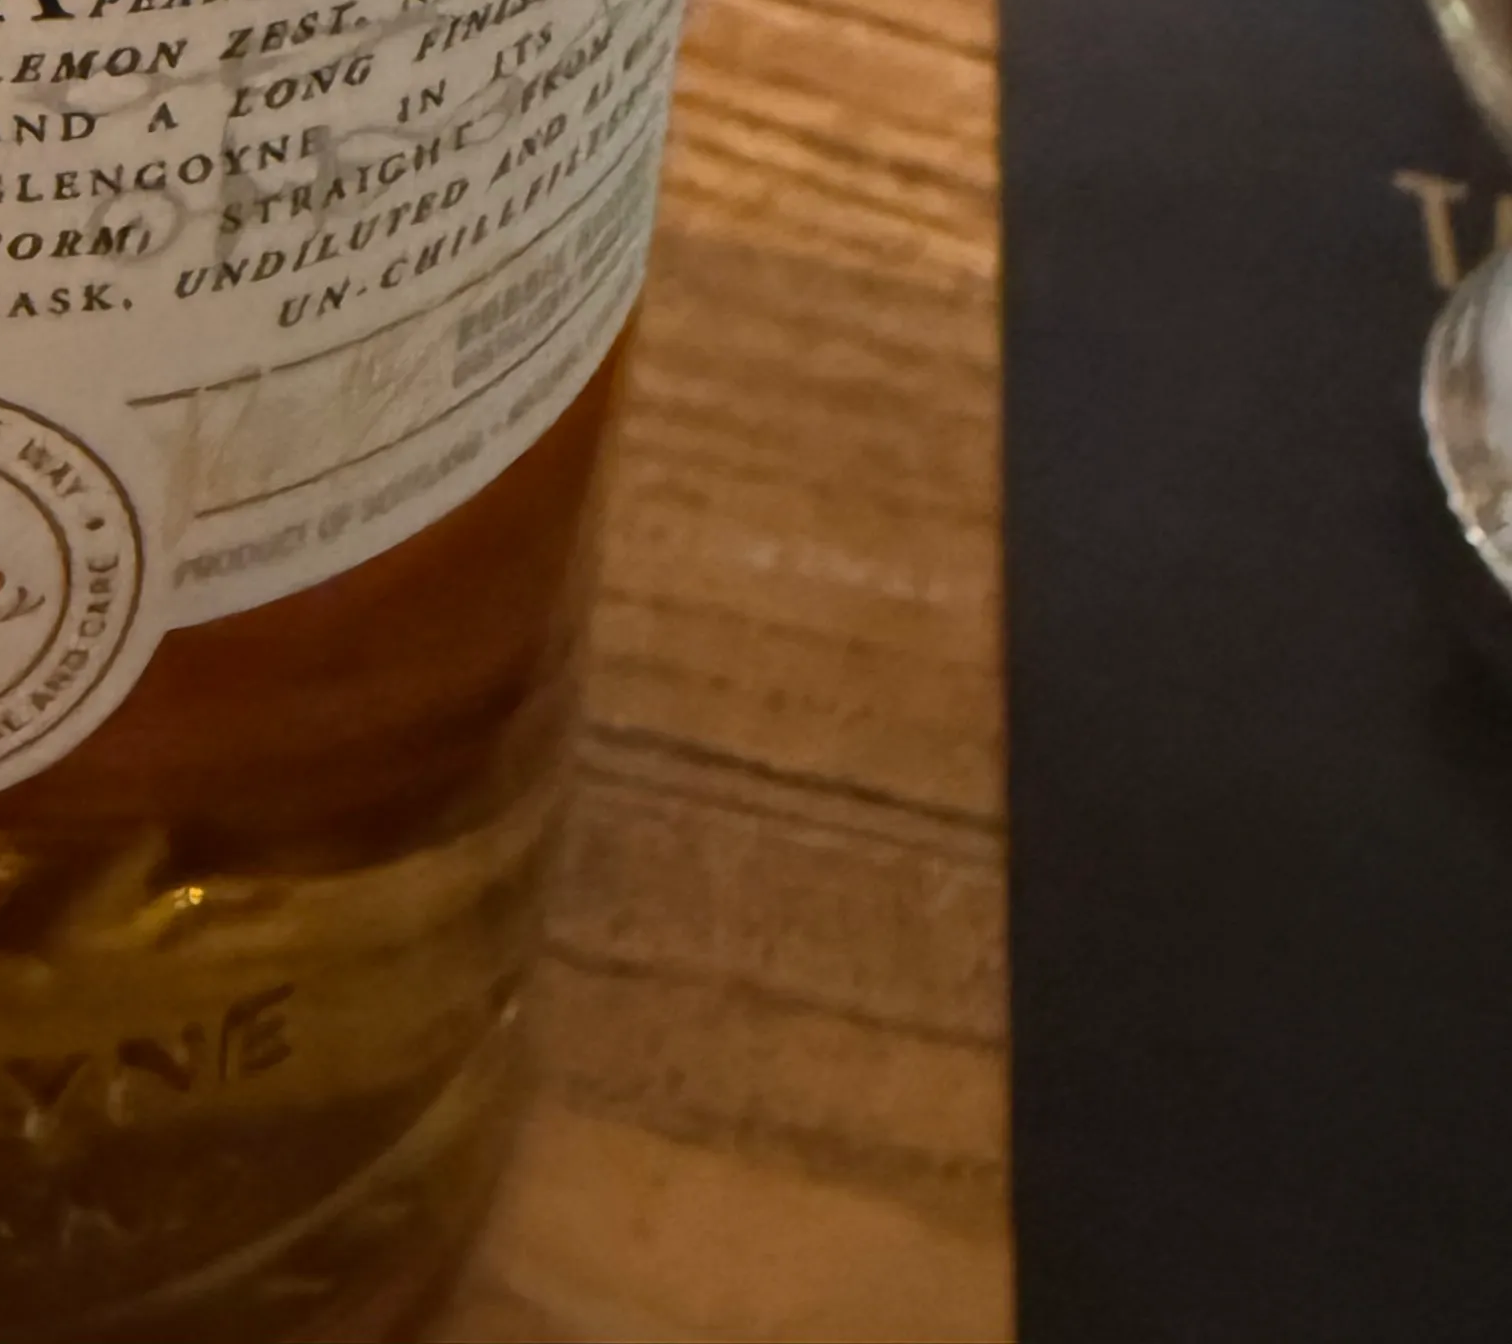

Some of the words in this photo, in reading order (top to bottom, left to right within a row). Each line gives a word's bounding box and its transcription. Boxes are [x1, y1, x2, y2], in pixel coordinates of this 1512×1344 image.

[146, 99, 181, 135] A
[228, 52, 377, 121] LONG
[218, 119, 474, 237] STRAIGHT
[520, 26, 614, 115] FROM
[396, 78, 448, 124] IN
[491, 20, 553, 86] ITS
[174, 177, 470, 303] UNDILUTED
[485, 112, 568, 194] AND
[17, 437, 86, 501] WAY
[30, 649, 90, 712] AND
[84, 553, 120, 641] CARE
